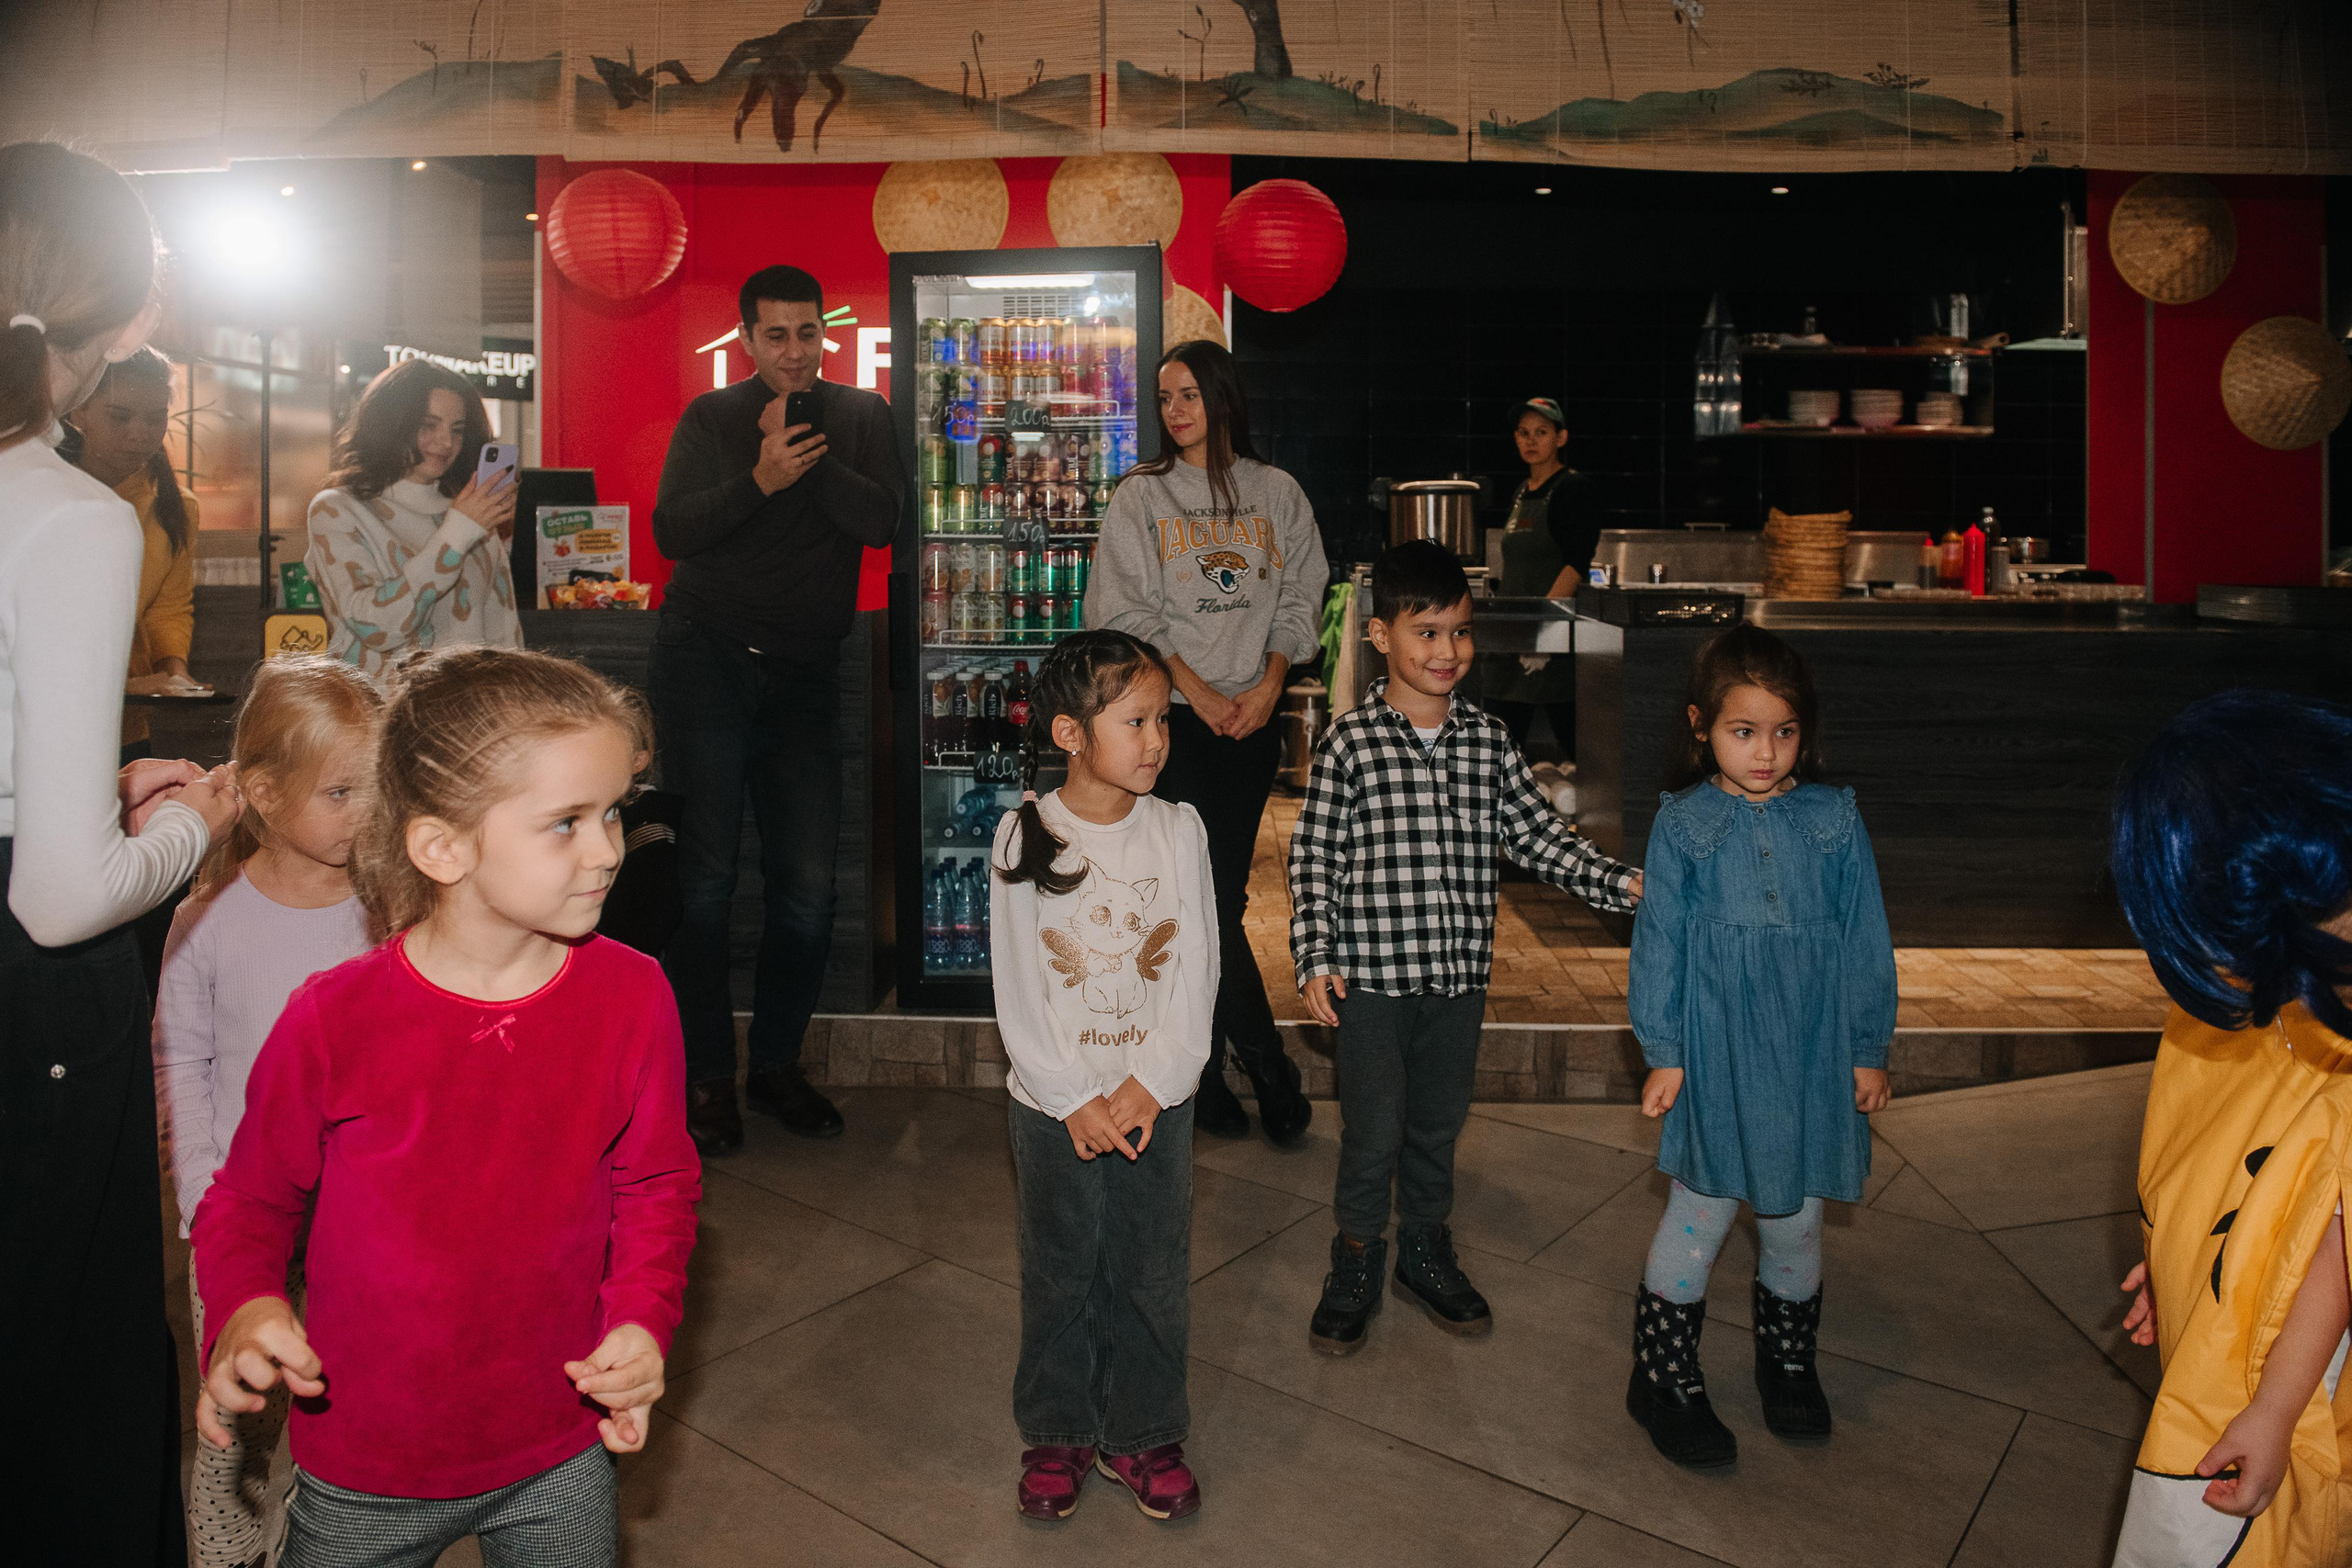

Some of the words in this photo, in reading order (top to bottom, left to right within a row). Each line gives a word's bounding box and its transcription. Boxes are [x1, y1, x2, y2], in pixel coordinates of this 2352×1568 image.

[1183, 505, 1258, 518] JACKSONILLE
[1194, 593, 1251, 614] Florida
[1079, 1024, 1148, 1046] #lovely
